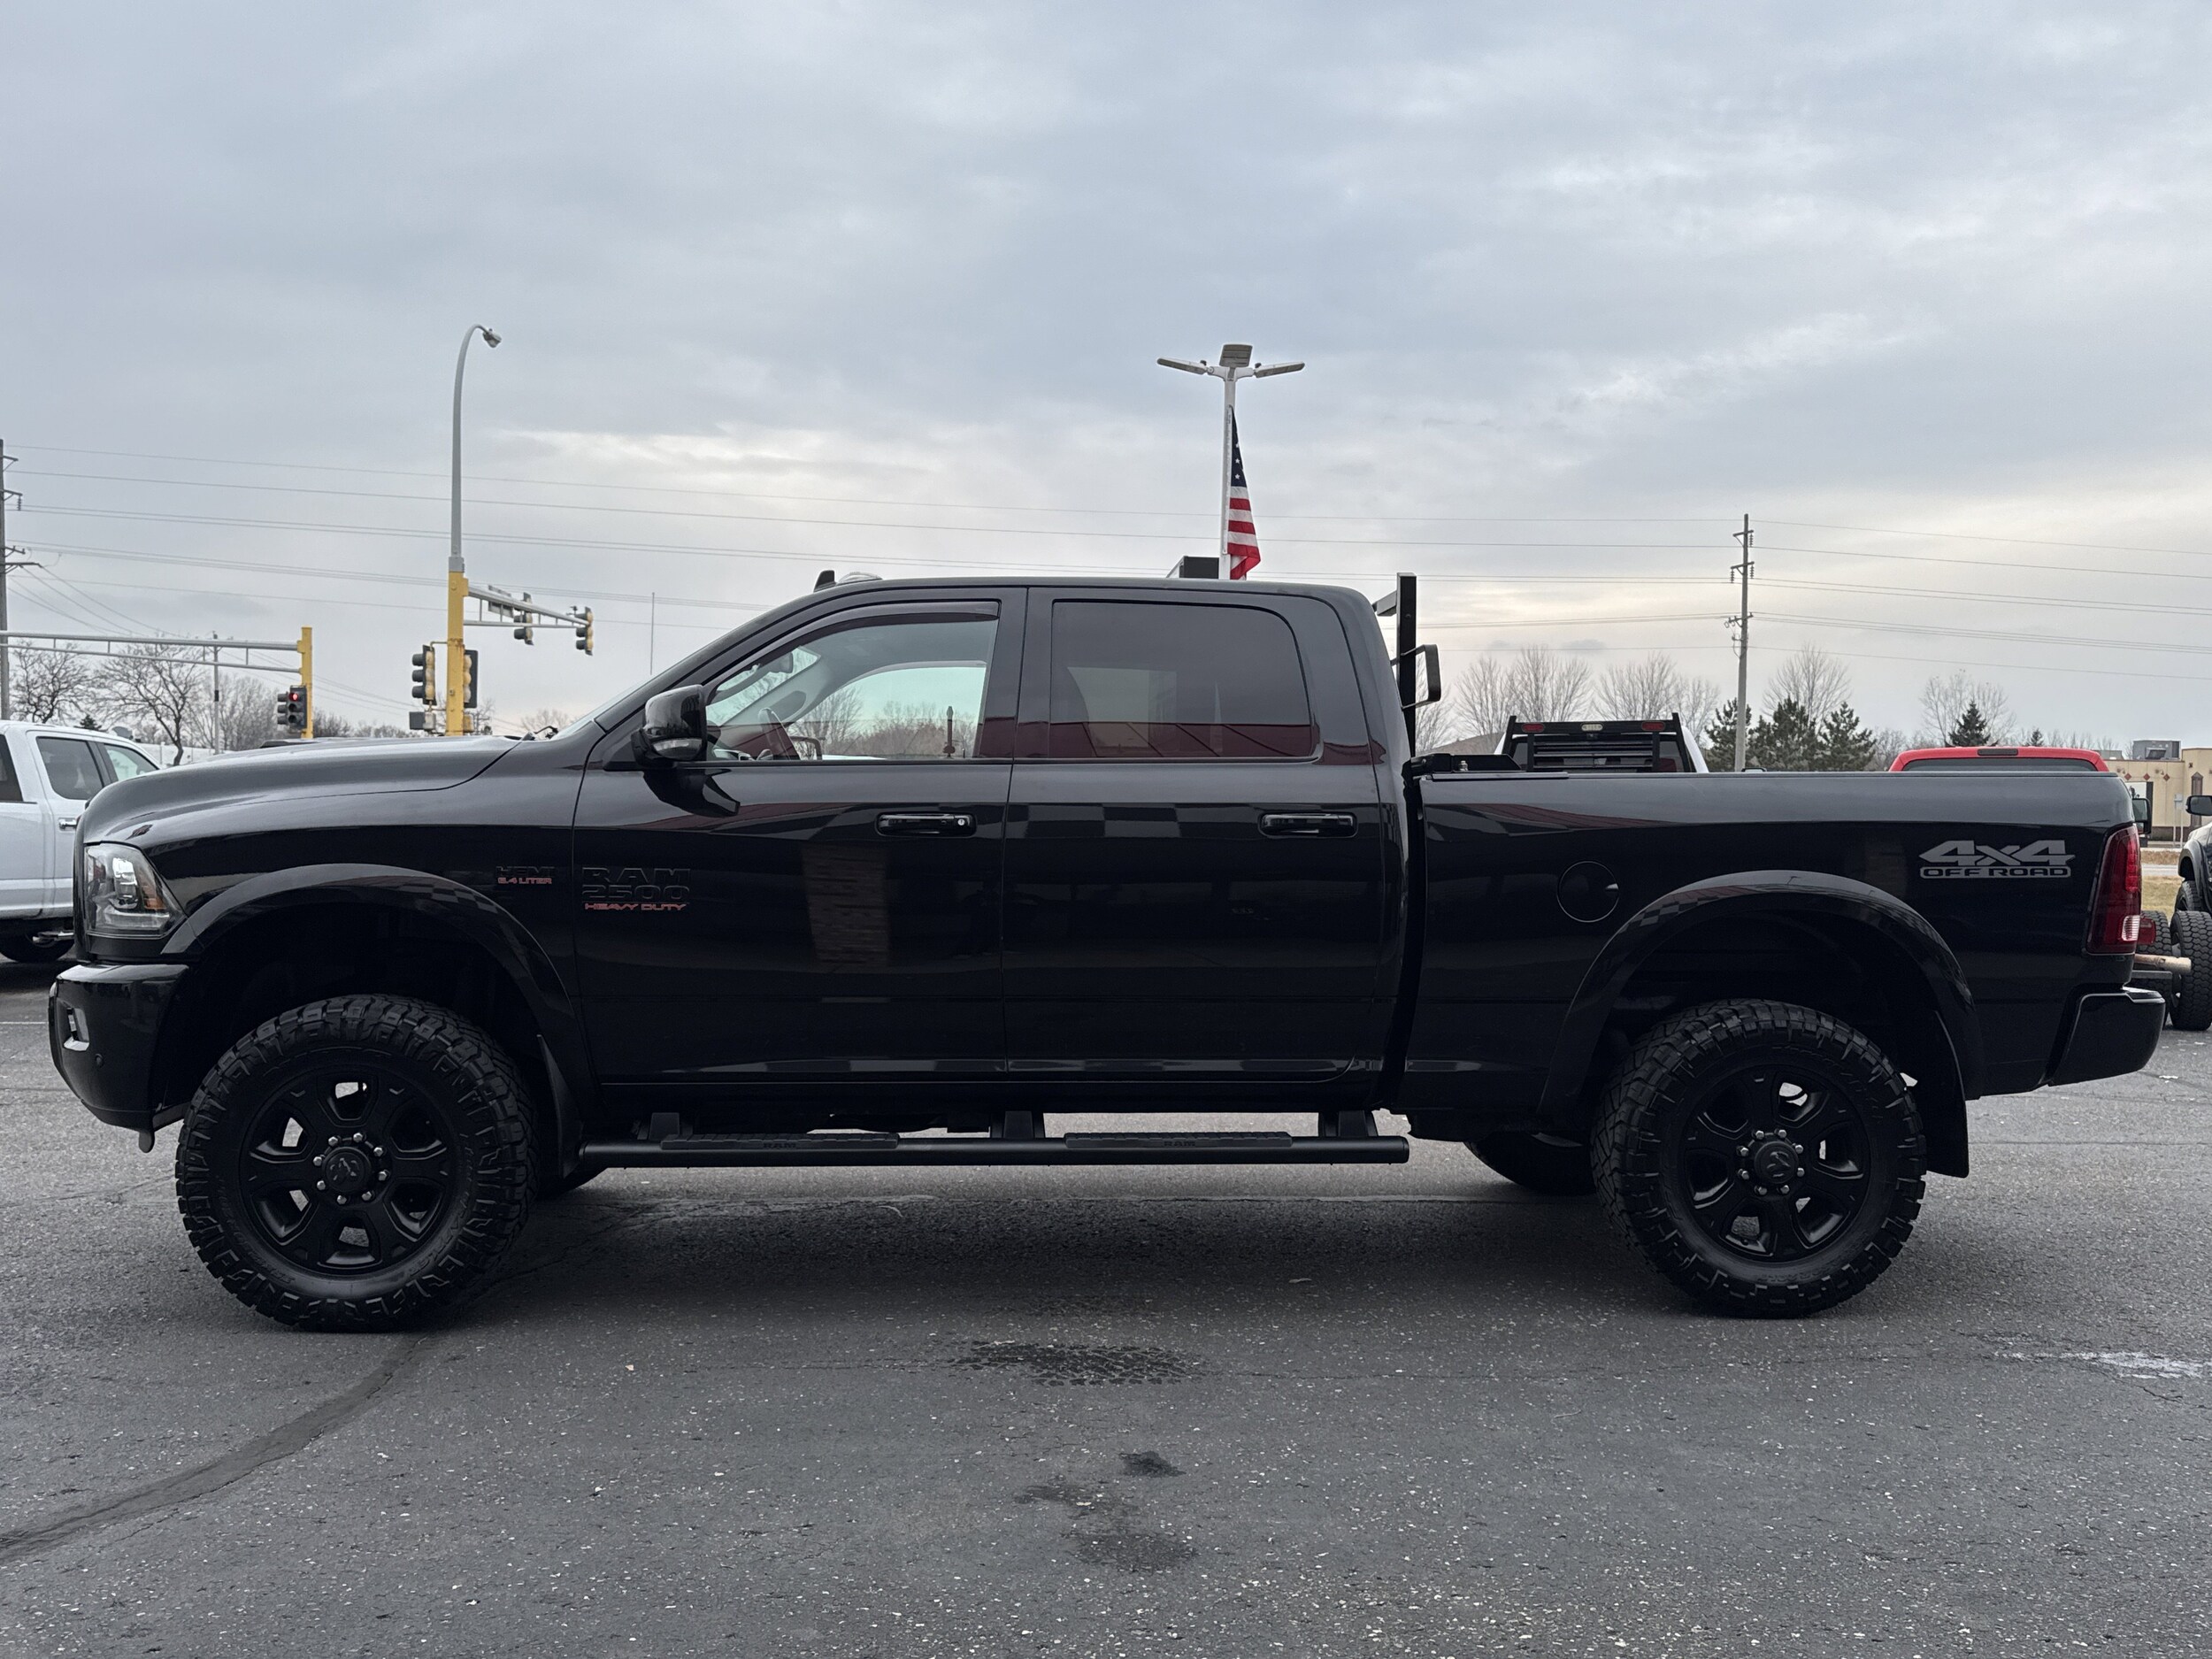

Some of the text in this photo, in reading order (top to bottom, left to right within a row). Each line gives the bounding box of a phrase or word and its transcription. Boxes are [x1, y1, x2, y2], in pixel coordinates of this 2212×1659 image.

[495, 866, 555, 878] HEMI
[582, 867, 690, 884] RAM
[1923, 867, 2069, 877] OFF ROAD
[582, 885, 690, 902] 2500
[641, 902, 687, 911] DUTY
